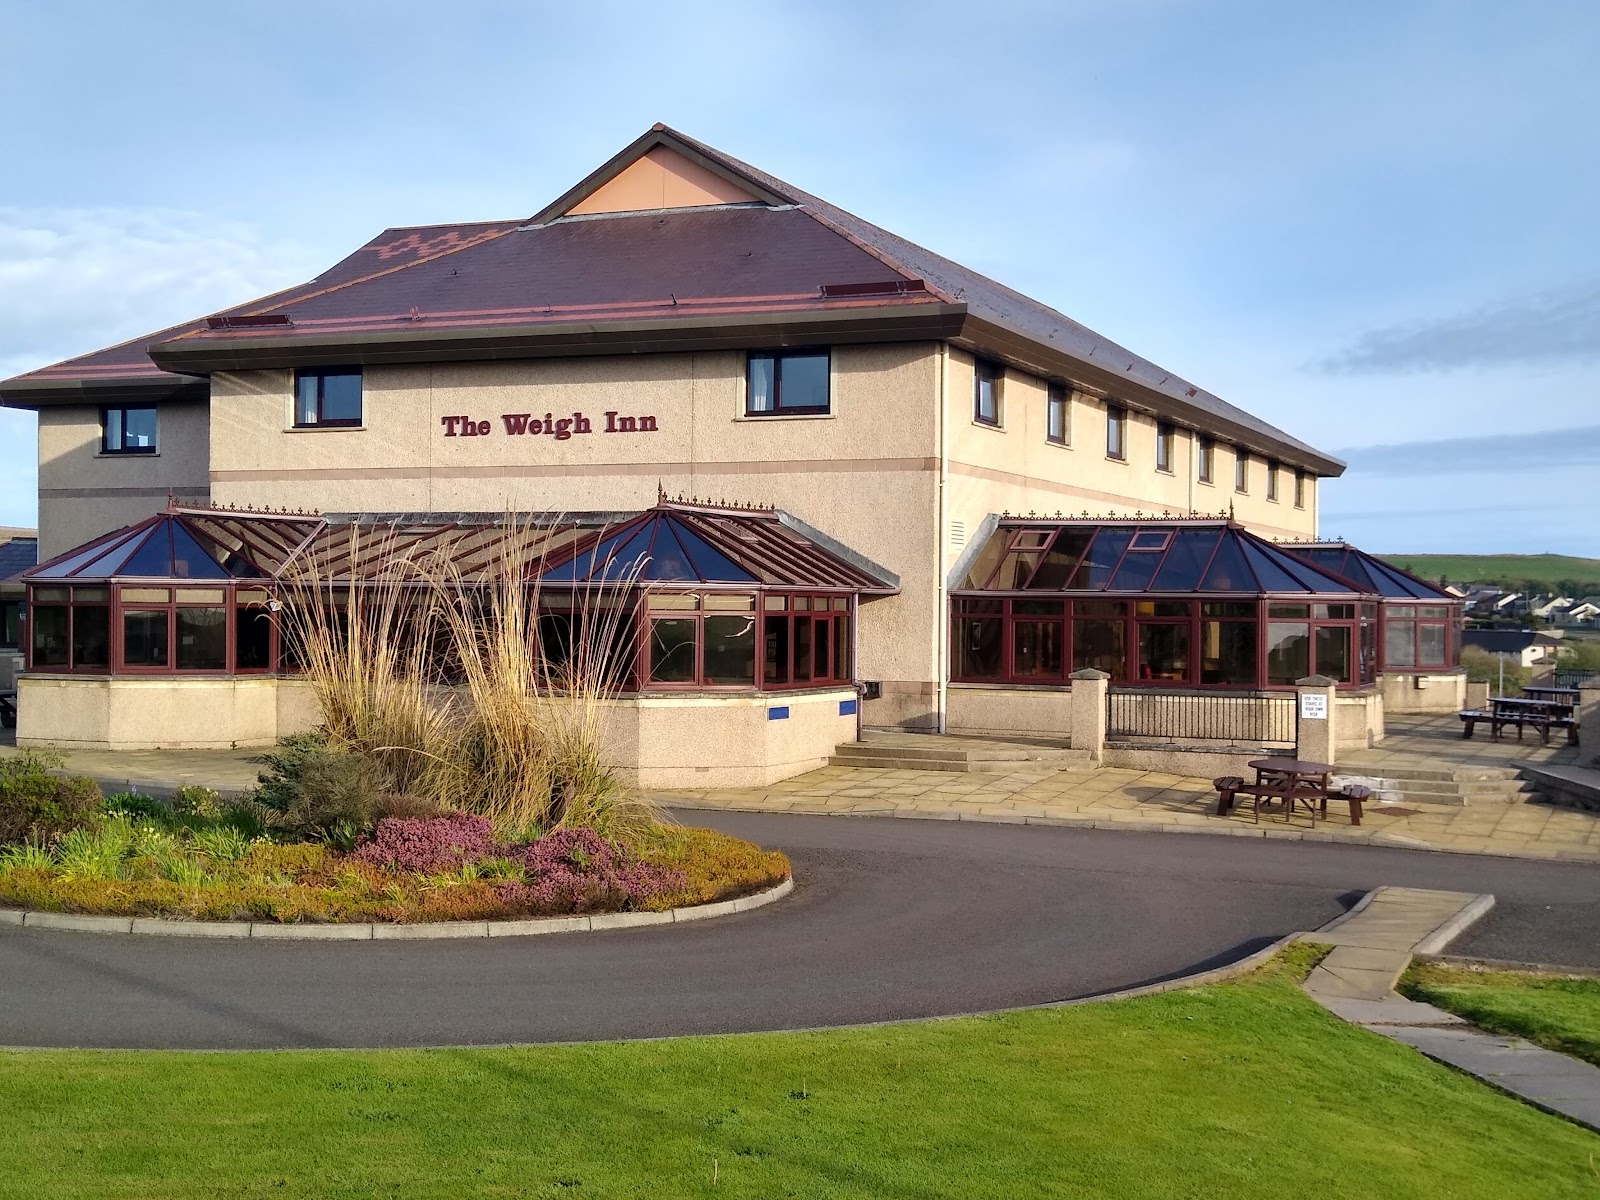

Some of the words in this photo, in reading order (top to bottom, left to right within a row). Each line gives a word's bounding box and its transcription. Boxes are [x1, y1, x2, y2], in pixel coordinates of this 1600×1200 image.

[441, 416, 491, 437] The
[501, 412, 592, 441] Weigh
[604, 411, 659, 433] Inn
